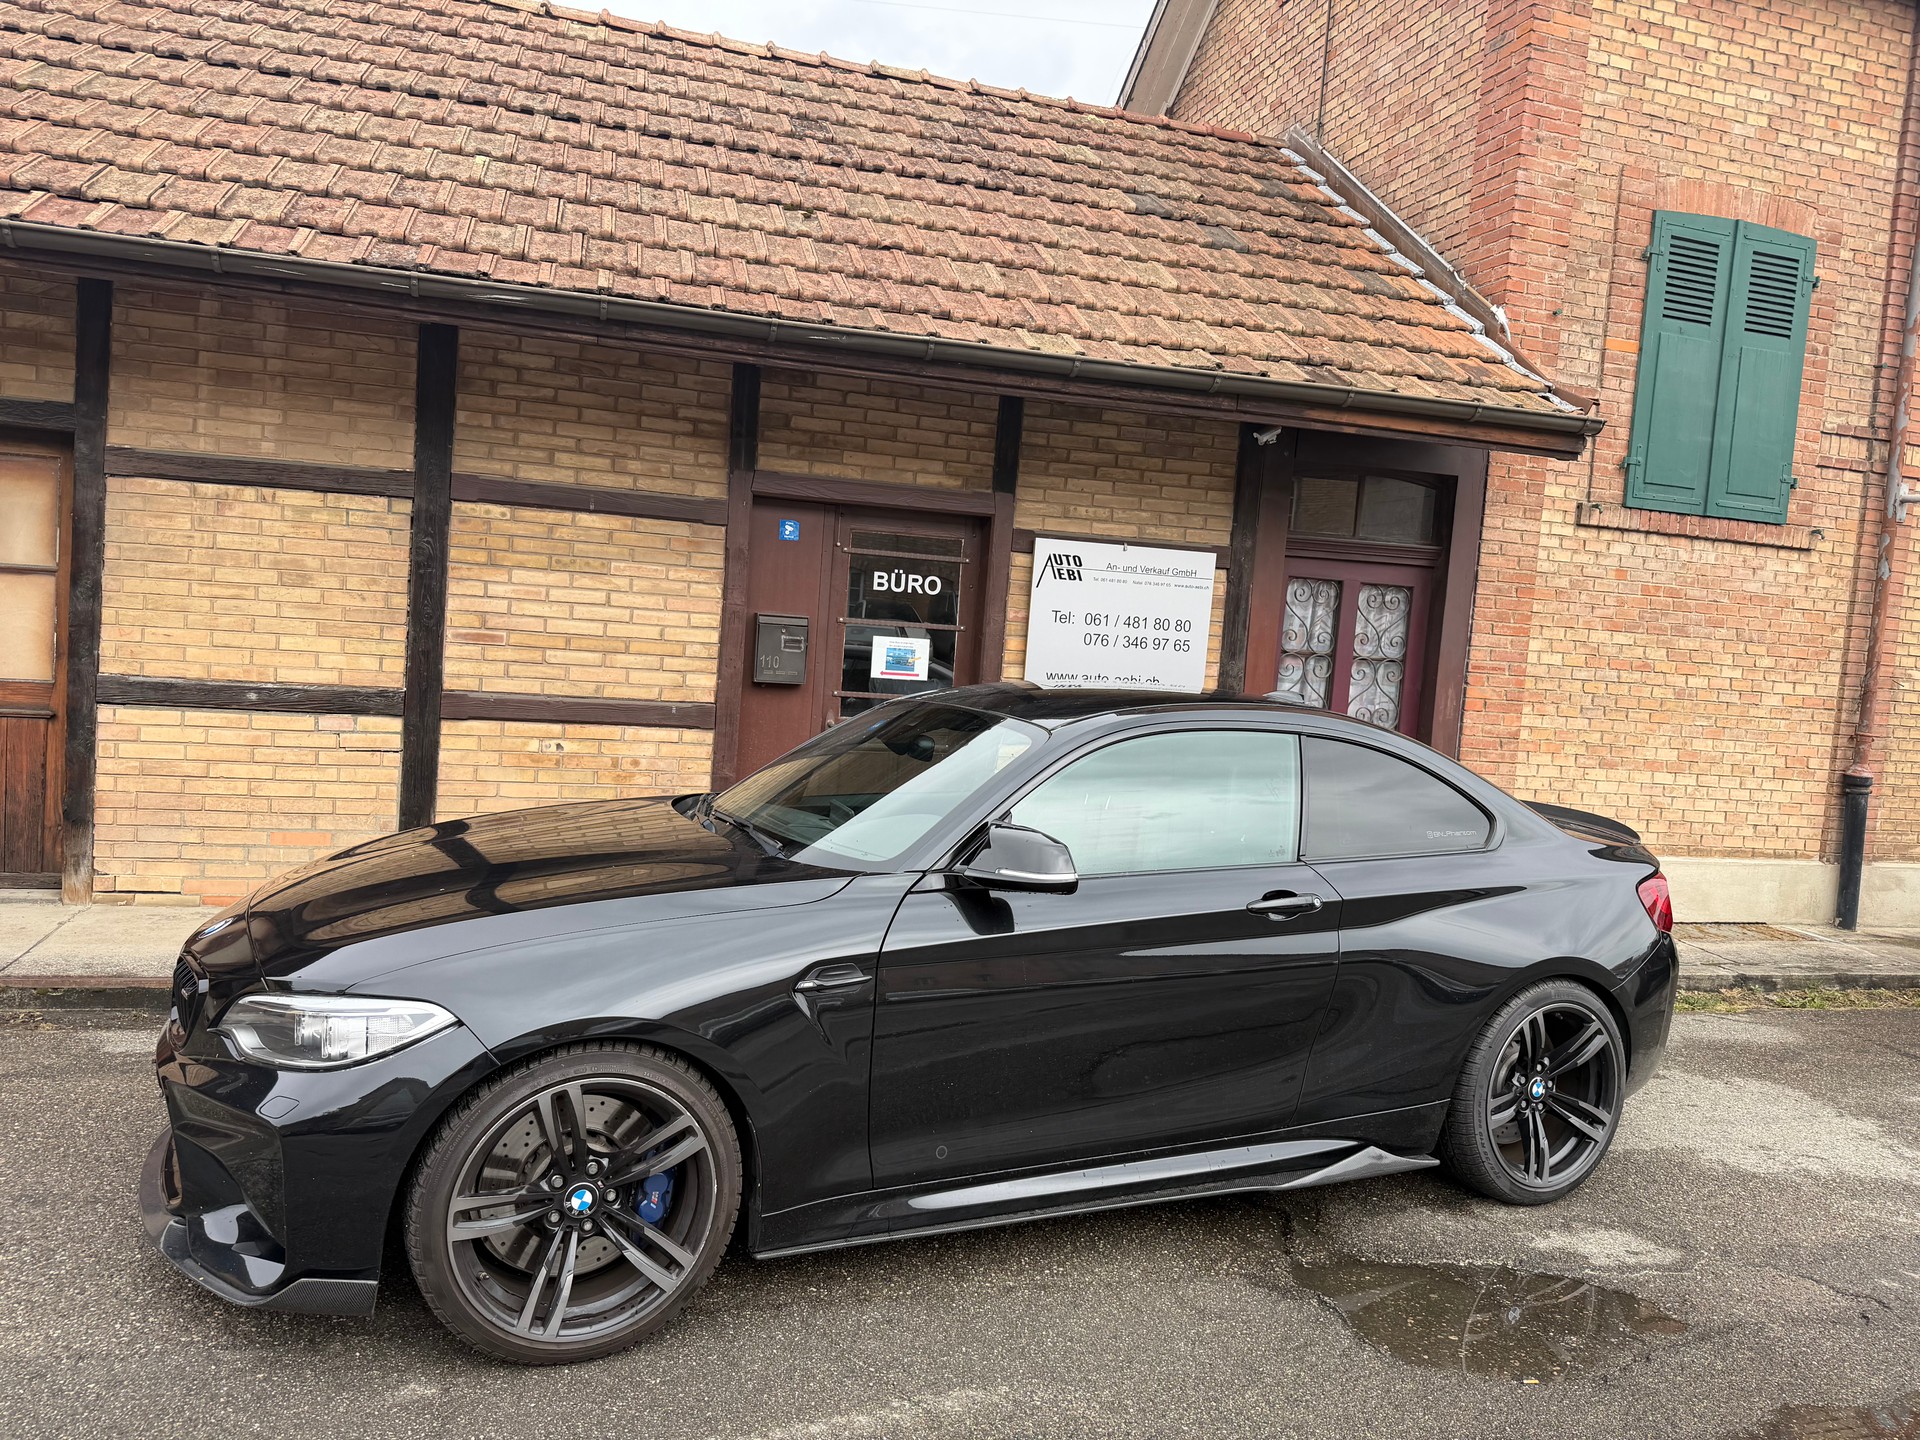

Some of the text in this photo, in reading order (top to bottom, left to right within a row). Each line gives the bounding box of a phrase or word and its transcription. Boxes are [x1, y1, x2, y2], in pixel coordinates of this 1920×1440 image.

[1122, 564, 1138, 573] und
[1139, 564, 1171, 575] Verkauf
[1171, 567, 1198, 578] GmbH
[873, 569, 942, 595] BÜRO
[1051, 610, 1192, 632] Tel: 061 / 481 80 80
[1083, 632, 1191, 652] 076 / 346 97 65
[760, 654, 780, 669] 110
